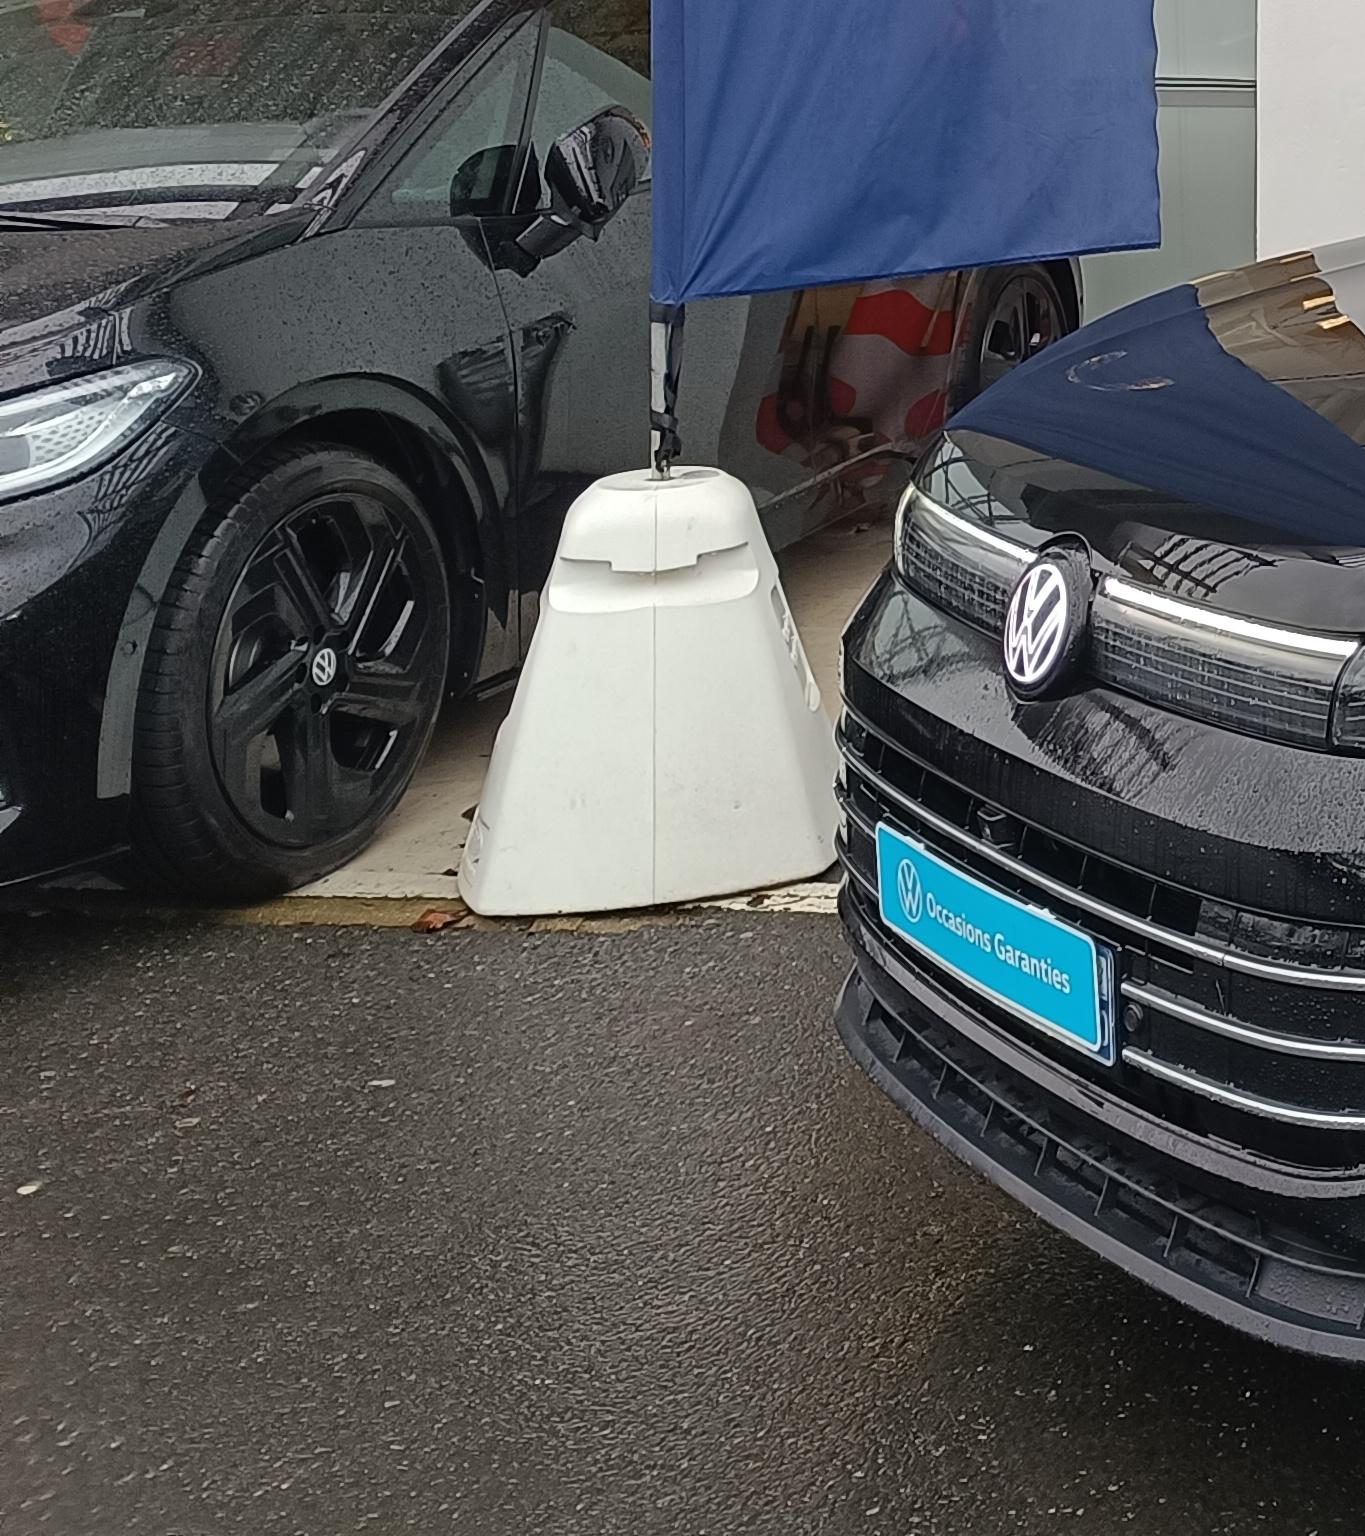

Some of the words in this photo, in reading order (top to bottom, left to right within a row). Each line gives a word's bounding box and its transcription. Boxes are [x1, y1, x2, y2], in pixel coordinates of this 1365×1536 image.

[1004, 564, 1066, 683] VW
[926, 892, 992, 953] Occasions
[994, 933, 1071, 995] Garanties
